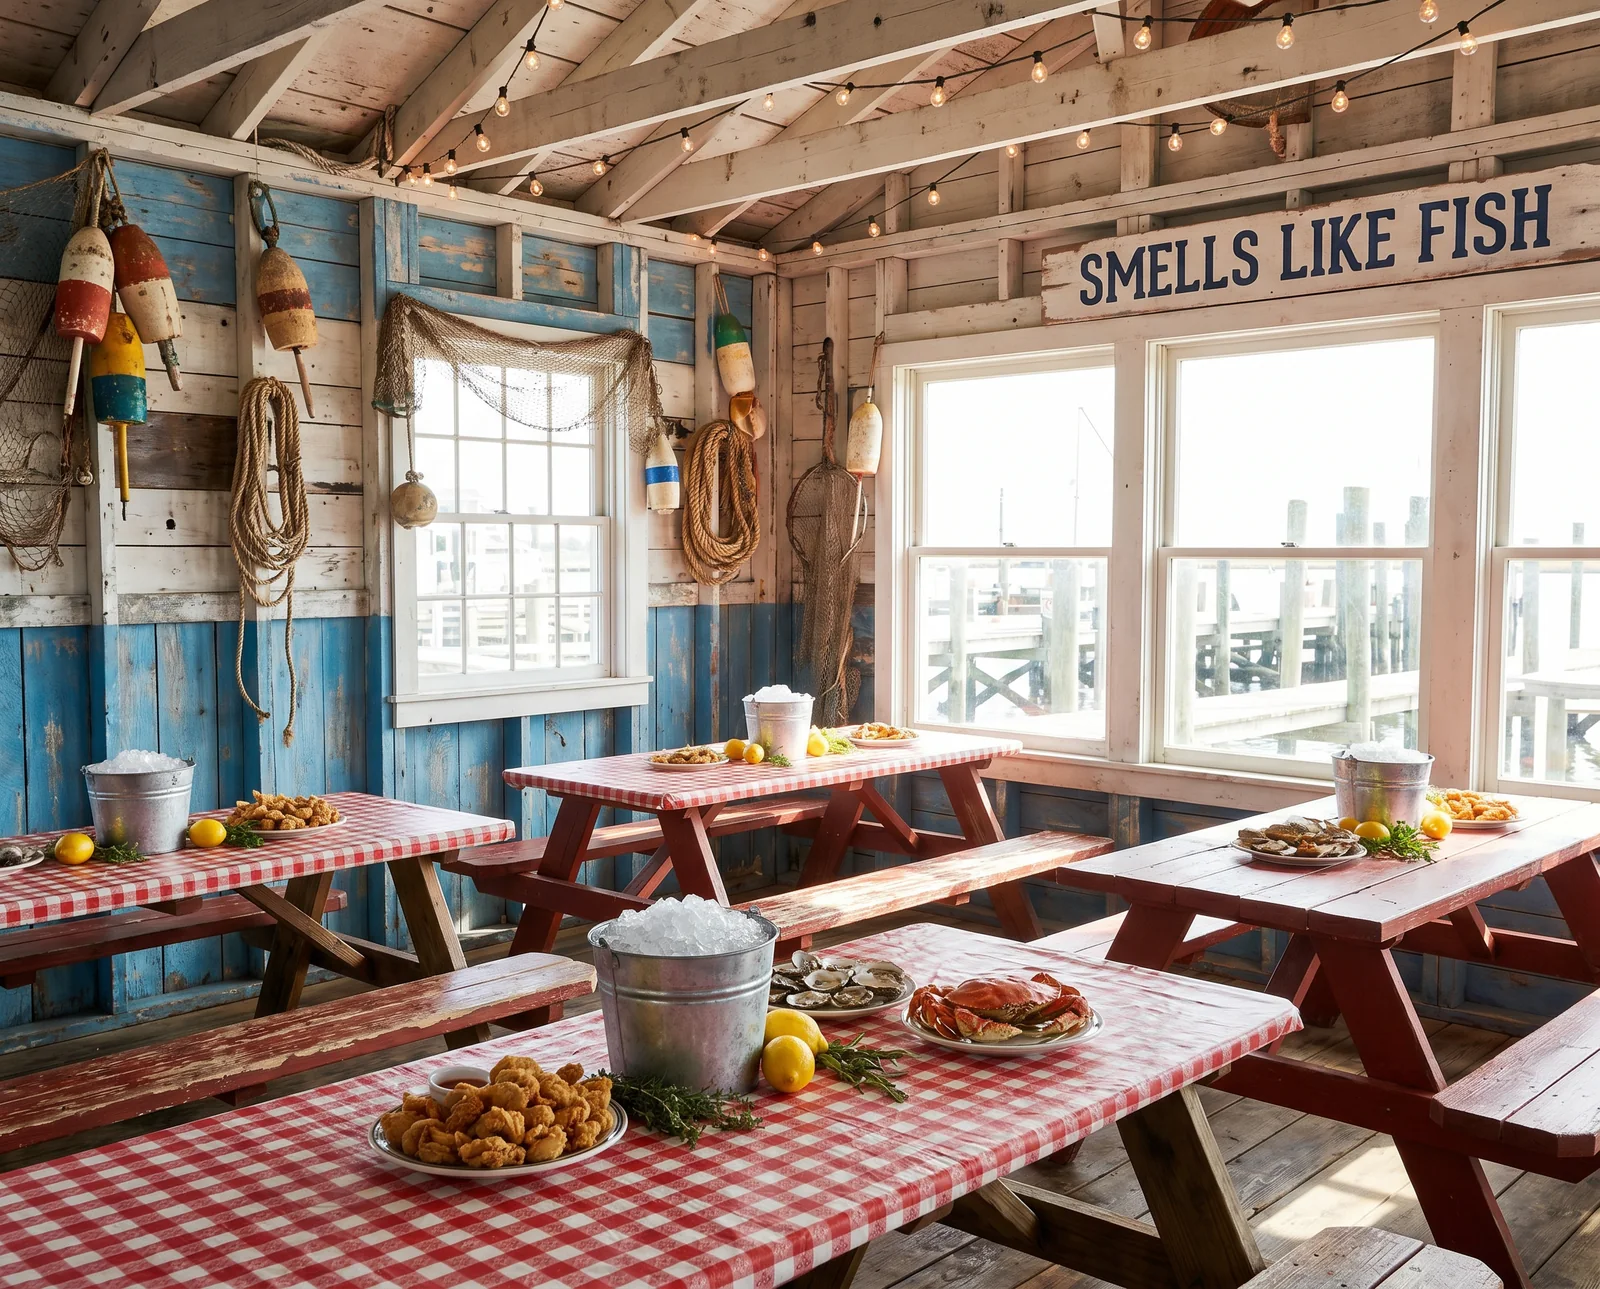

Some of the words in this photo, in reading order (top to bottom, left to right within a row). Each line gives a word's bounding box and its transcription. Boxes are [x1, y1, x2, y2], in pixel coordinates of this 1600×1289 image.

[1080, 230, 1259, 306] SMELLS
[1280, 208, 1395, 281] LIKE
[1418, 184, 1553, 263] FISH
